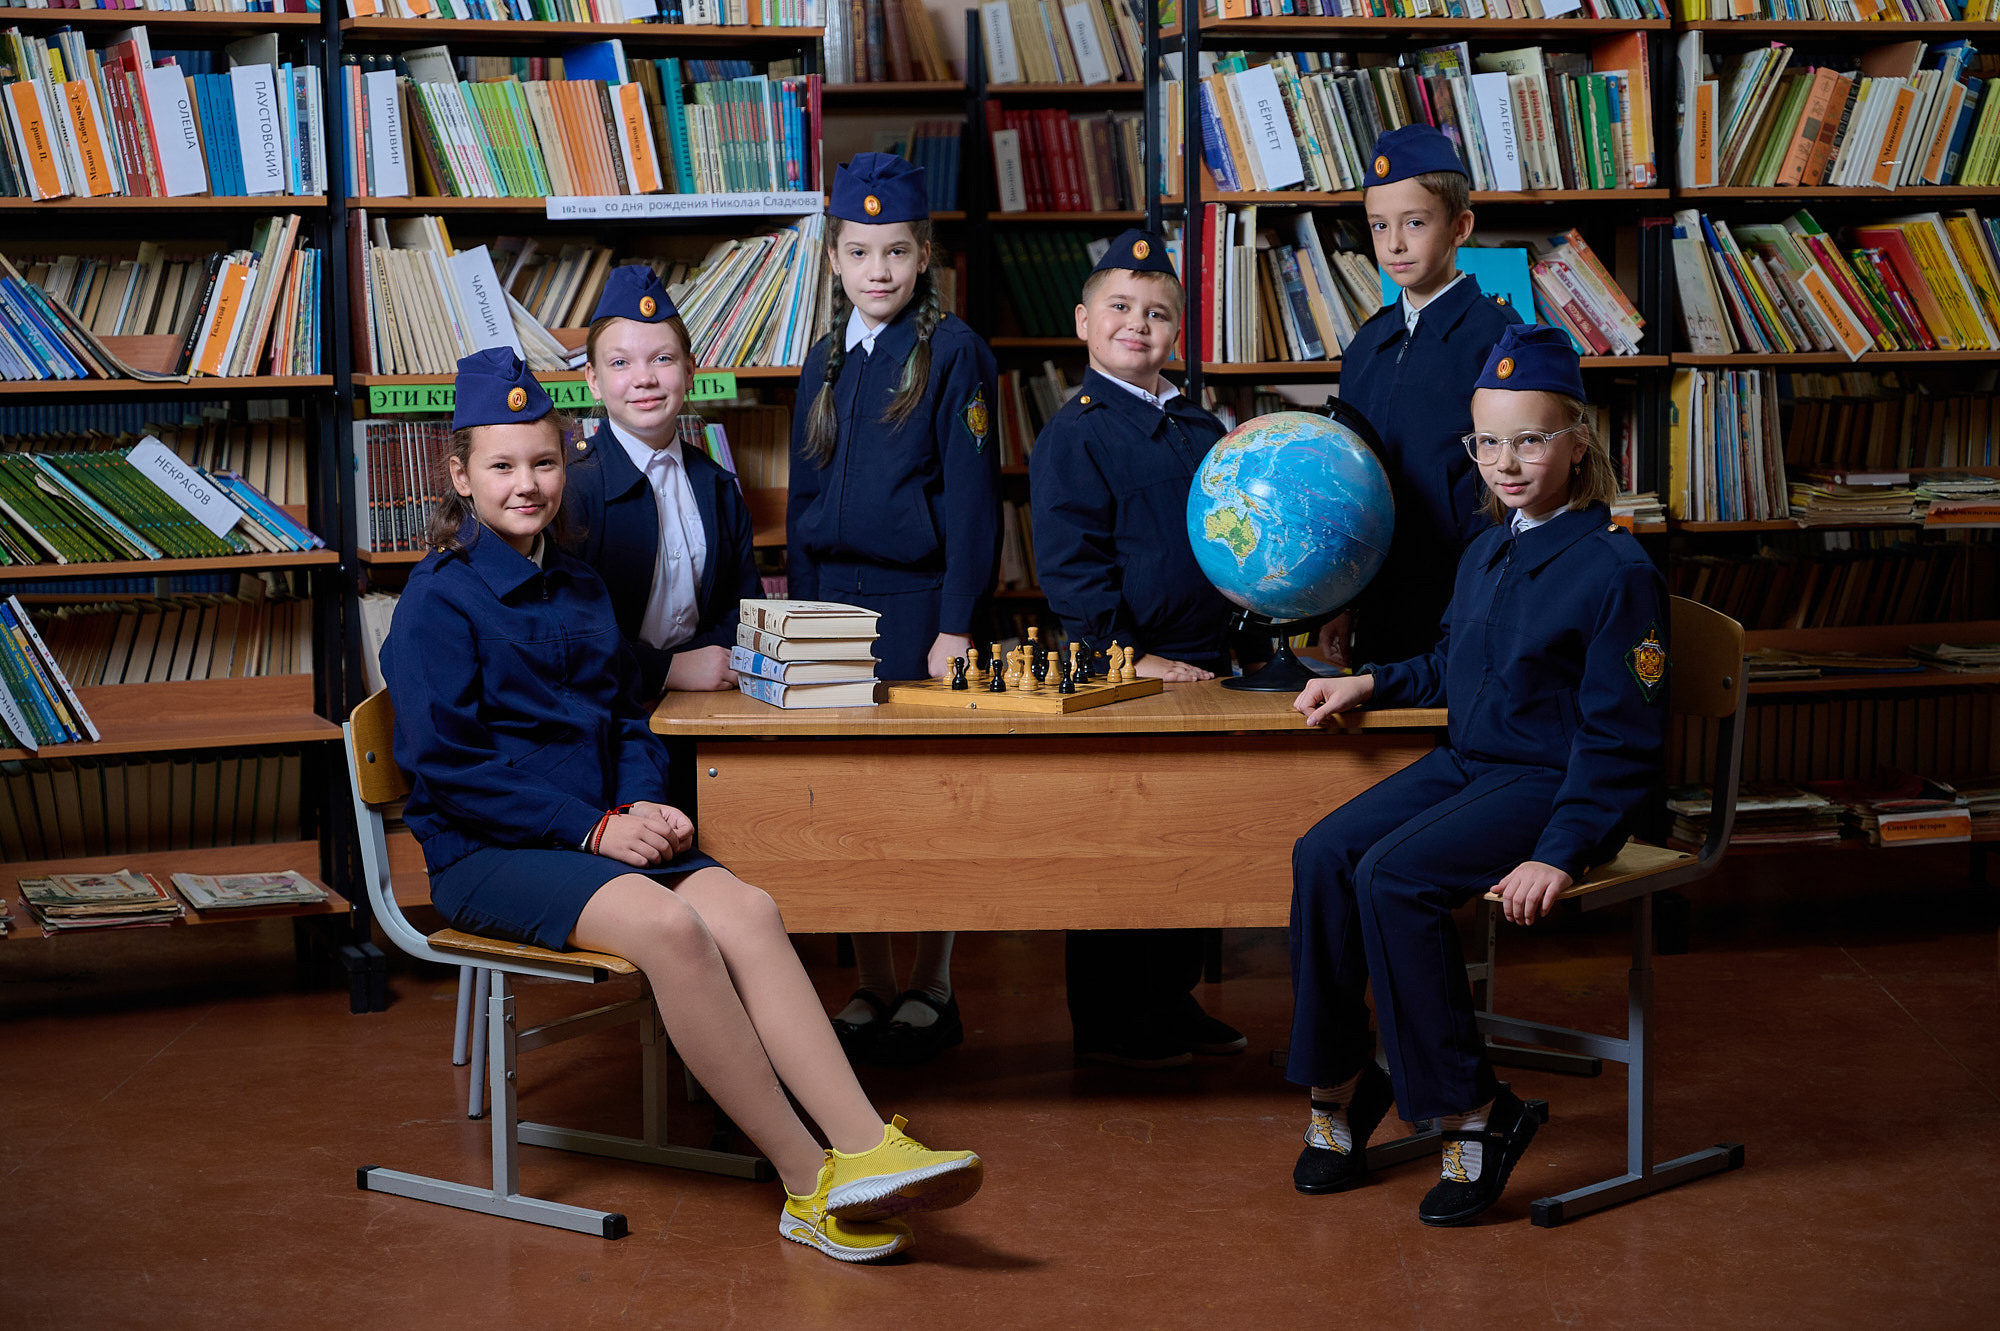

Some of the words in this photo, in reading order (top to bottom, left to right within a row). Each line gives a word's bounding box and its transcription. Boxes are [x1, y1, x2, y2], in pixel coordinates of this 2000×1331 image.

[31, 120, 43, 150] Ершов
[39, 150, 48, 162] П.
[74, 105, 90, 144] Сибиряк
[177, 99, 197, 150] ОЛЕША
[254, 80, 280, 178] ПАУСТОВСКИЙ
[386, 97, 400, 165] ПРИШВИН
[632, 126, 642, 160] Сладков
[1258, 99, 1282, 151] БЁРНЕТТ
[1498, 98, 1514, 162] ЛАГЕРЛЕФ
[1884, 105, 1905, 158] Маяковский
[86, 150, 99, 181] Мамин
[561, 206, 576, 214] 102
[578, 206, 597, 215] года
[605, 203, 619, 212] со
[621, 202, 644, 212] дня
[648, 199, 708, 213] рождения
[710, 197, 760, 209] Николая
[763, 196, 817, 208] Сладкова
[210, 305, 226, 338] Толстой
[222, 296, 229, 306] А.
[472, 274, 499, 337] ЧАРУШИН
[1816, 290, 1843, 330] Чуковский
[1844, 332, 1851, 340] К.
[374, 390, 418, 408] ЭТИ
[154, 454, 211, 506] НЕКРАСОВ
[0, 688, 24, 738] УШИНС
[1887, 824, 1907, 832] Книги
[1918, 822, 1946, 832] истории
